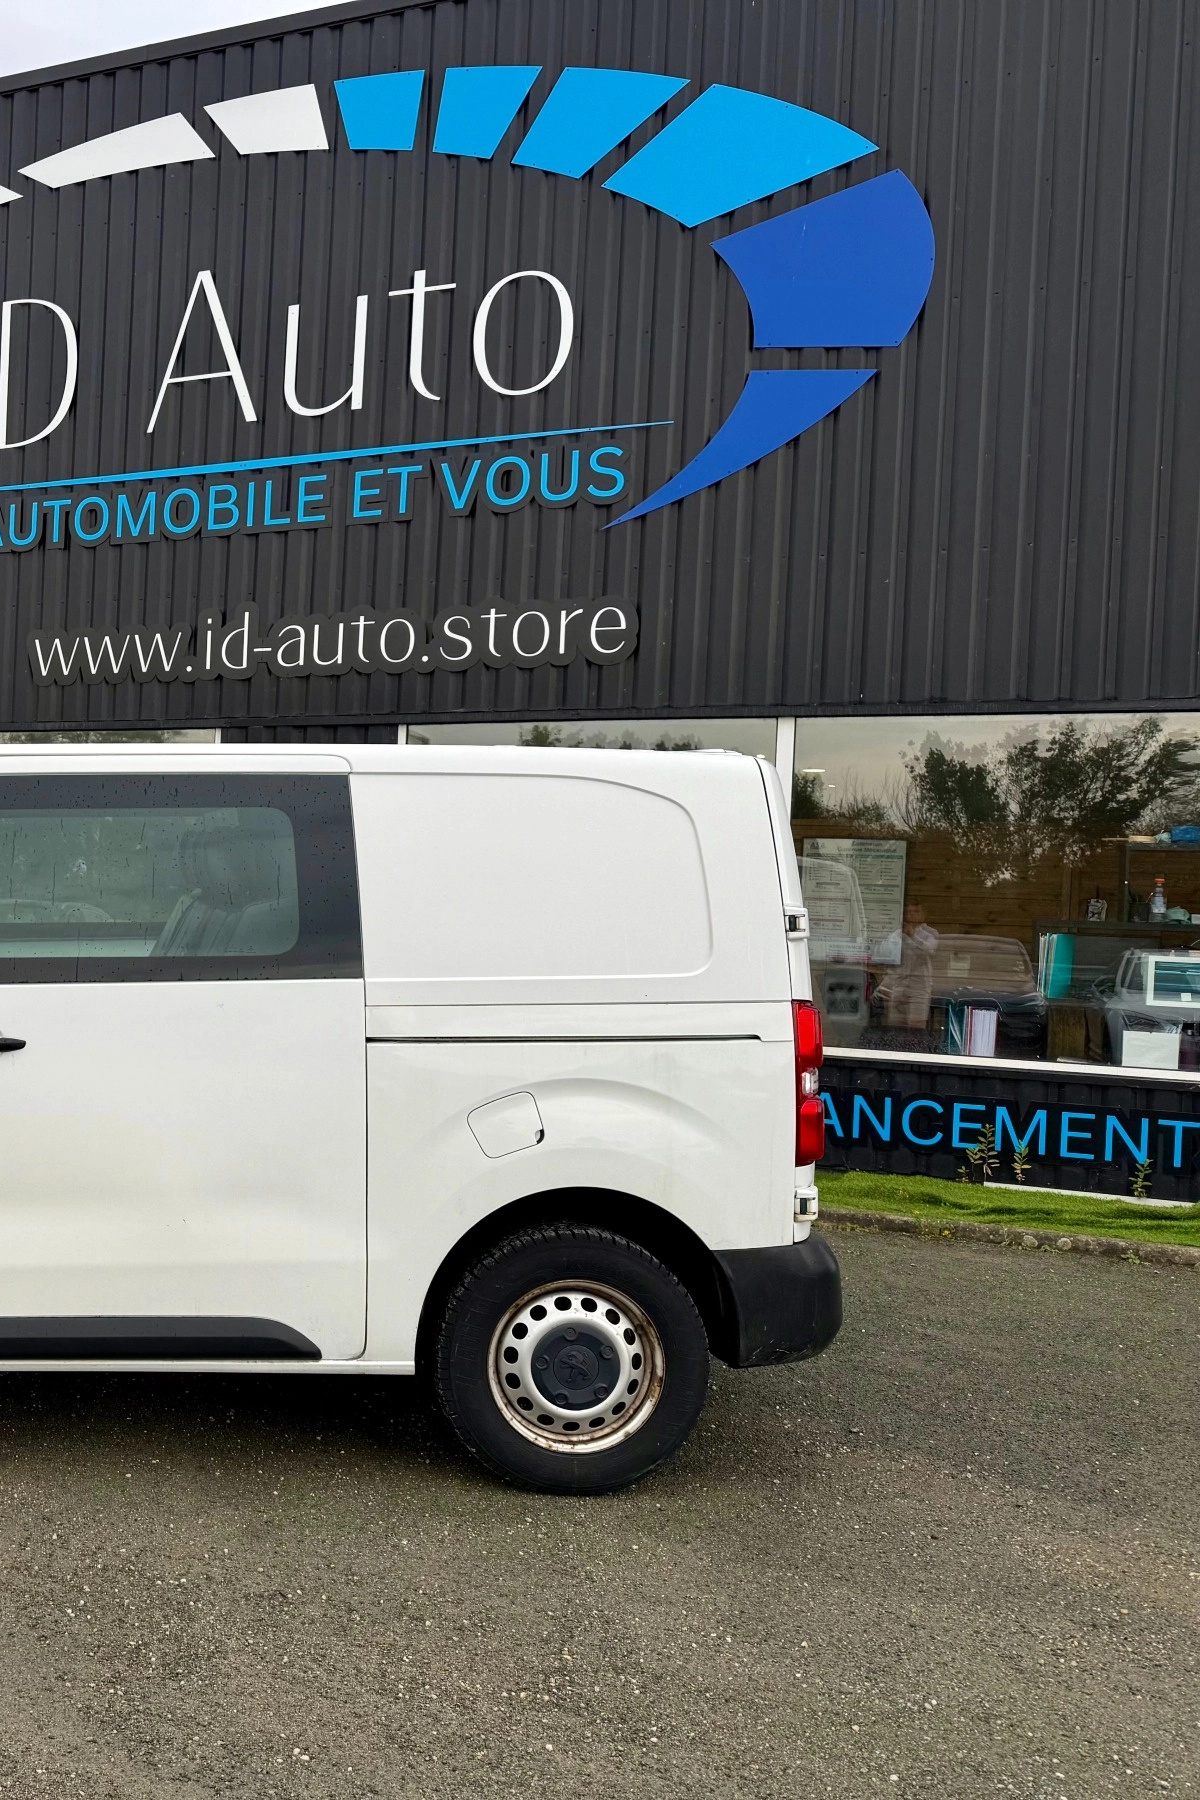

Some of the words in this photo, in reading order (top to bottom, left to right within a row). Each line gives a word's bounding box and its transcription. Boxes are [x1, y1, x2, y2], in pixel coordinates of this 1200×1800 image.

[147, 270, 574, 433] Auto
[352, 465, 423, 518] ET
[441, 447, 625, 510] VOUS
[34, 606, 628, 677] www.id-auto.store
